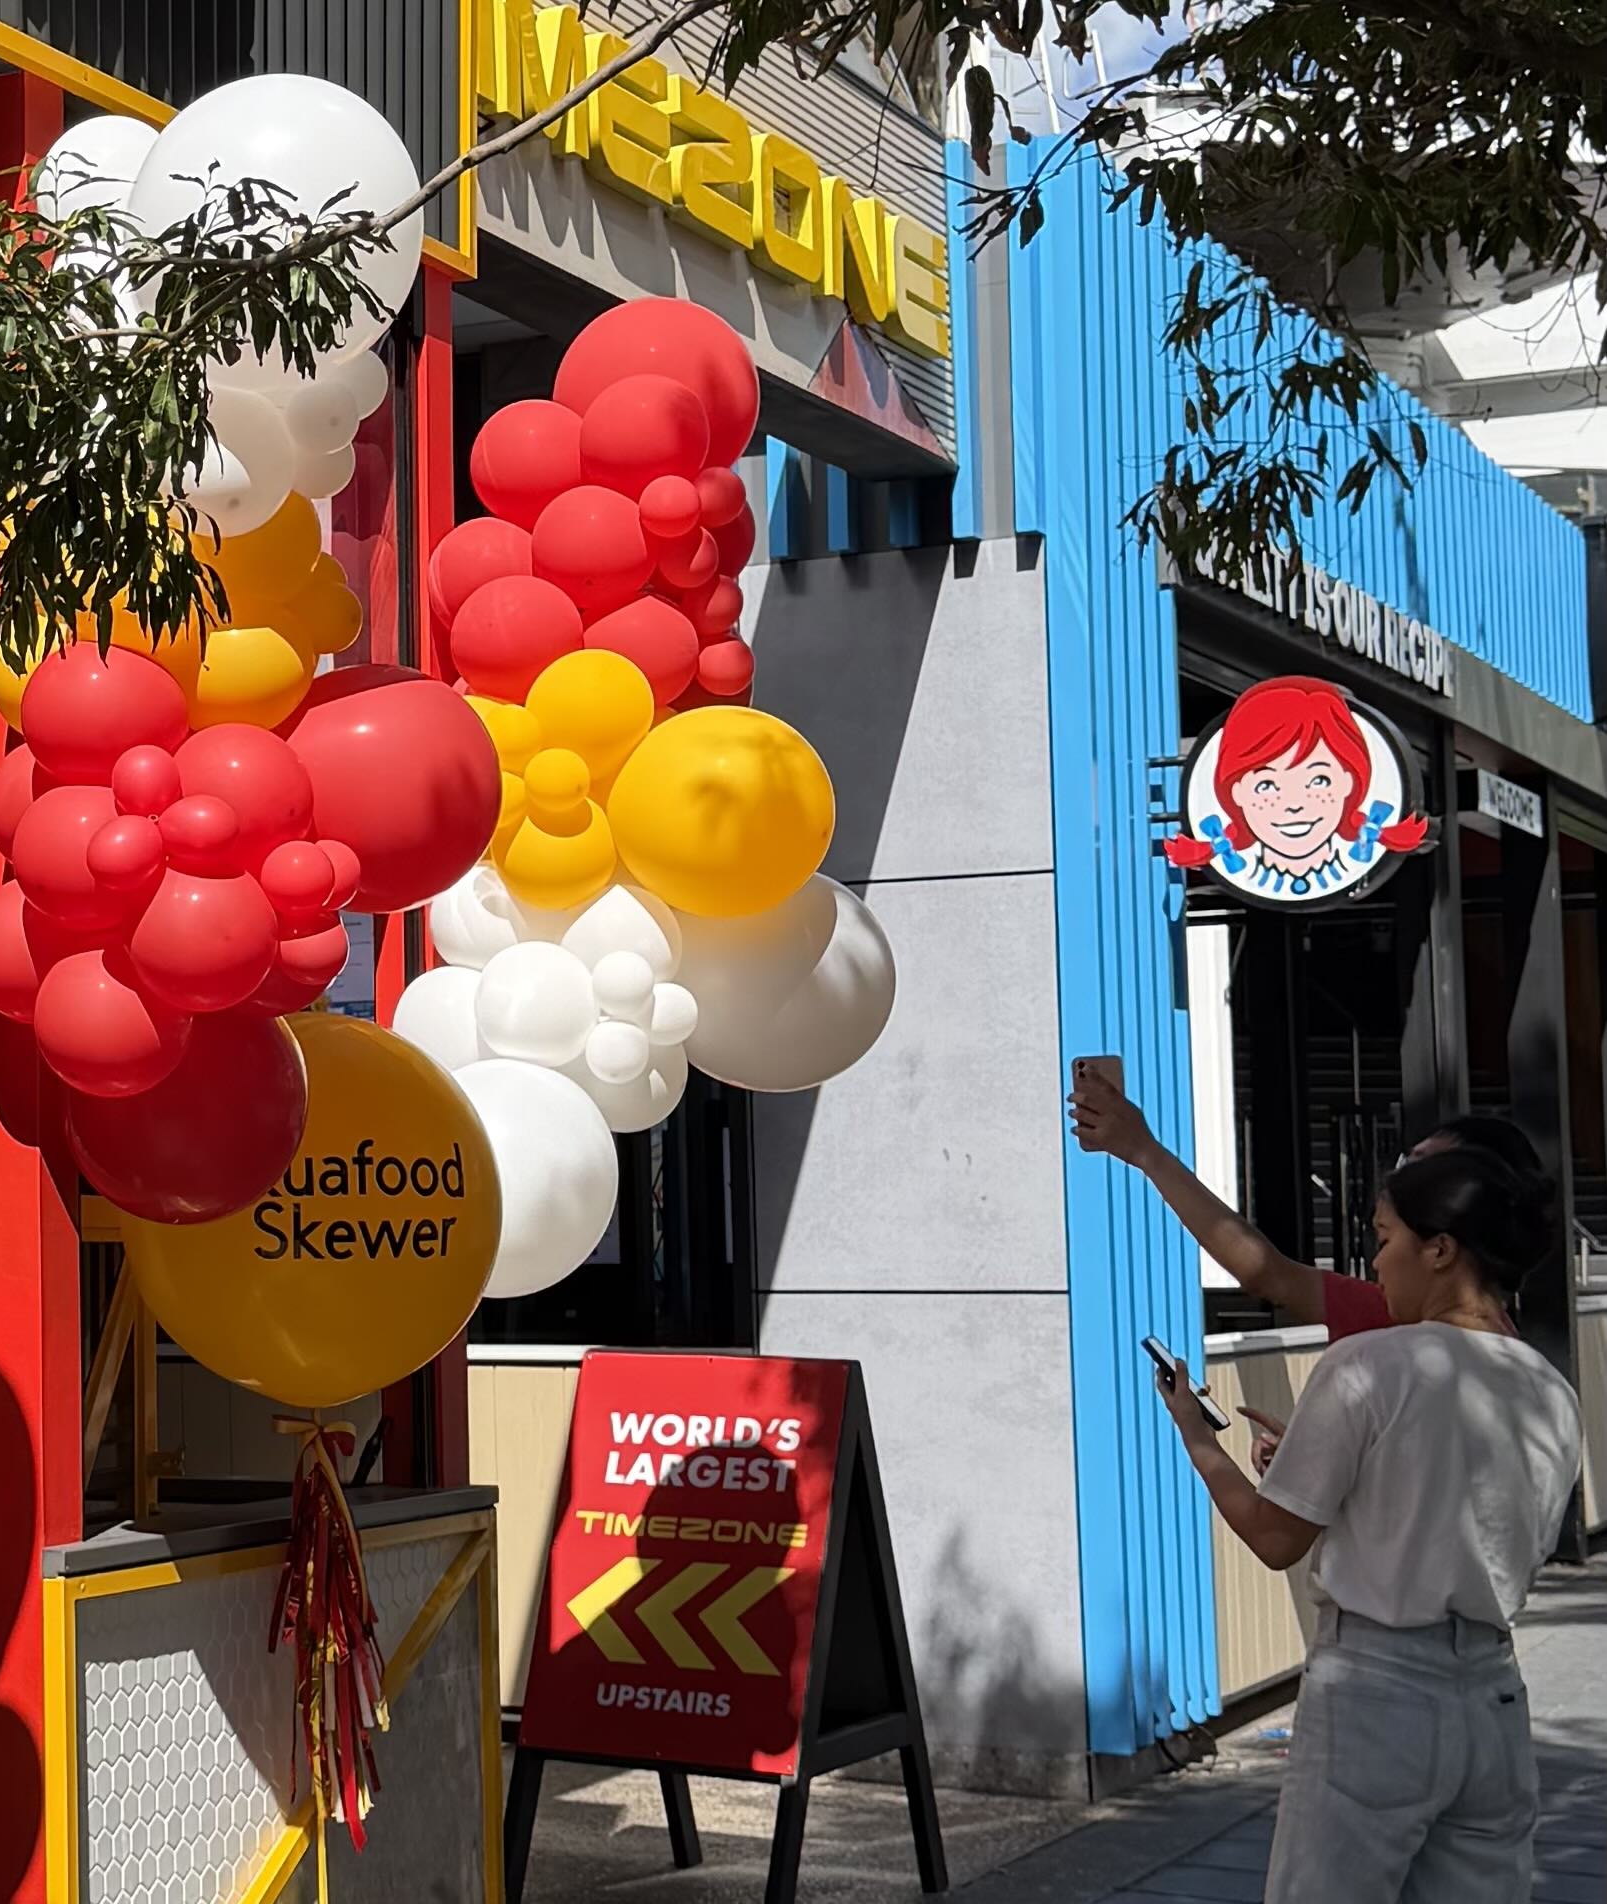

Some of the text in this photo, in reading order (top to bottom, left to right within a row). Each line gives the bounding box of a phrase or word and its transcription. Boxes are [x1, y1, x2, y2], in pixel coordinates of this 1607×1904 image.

[1305, 564, 1331, 636] IS
[1334, 579, 1383, 664] OUR
[1384, 604, 1455, 698] RECIPE
[267, 1138, 465, 1199] uafood
[252, 1201, 458, 1261] Skewer
[609, 1411, 802, 1452] WORLD'S
[603, 1451, 797, 1492] LARGEST
[575, 1509, 808, 1547] TIMEZONE
[596, 1682, 732, 1717] UPSTAIRS
